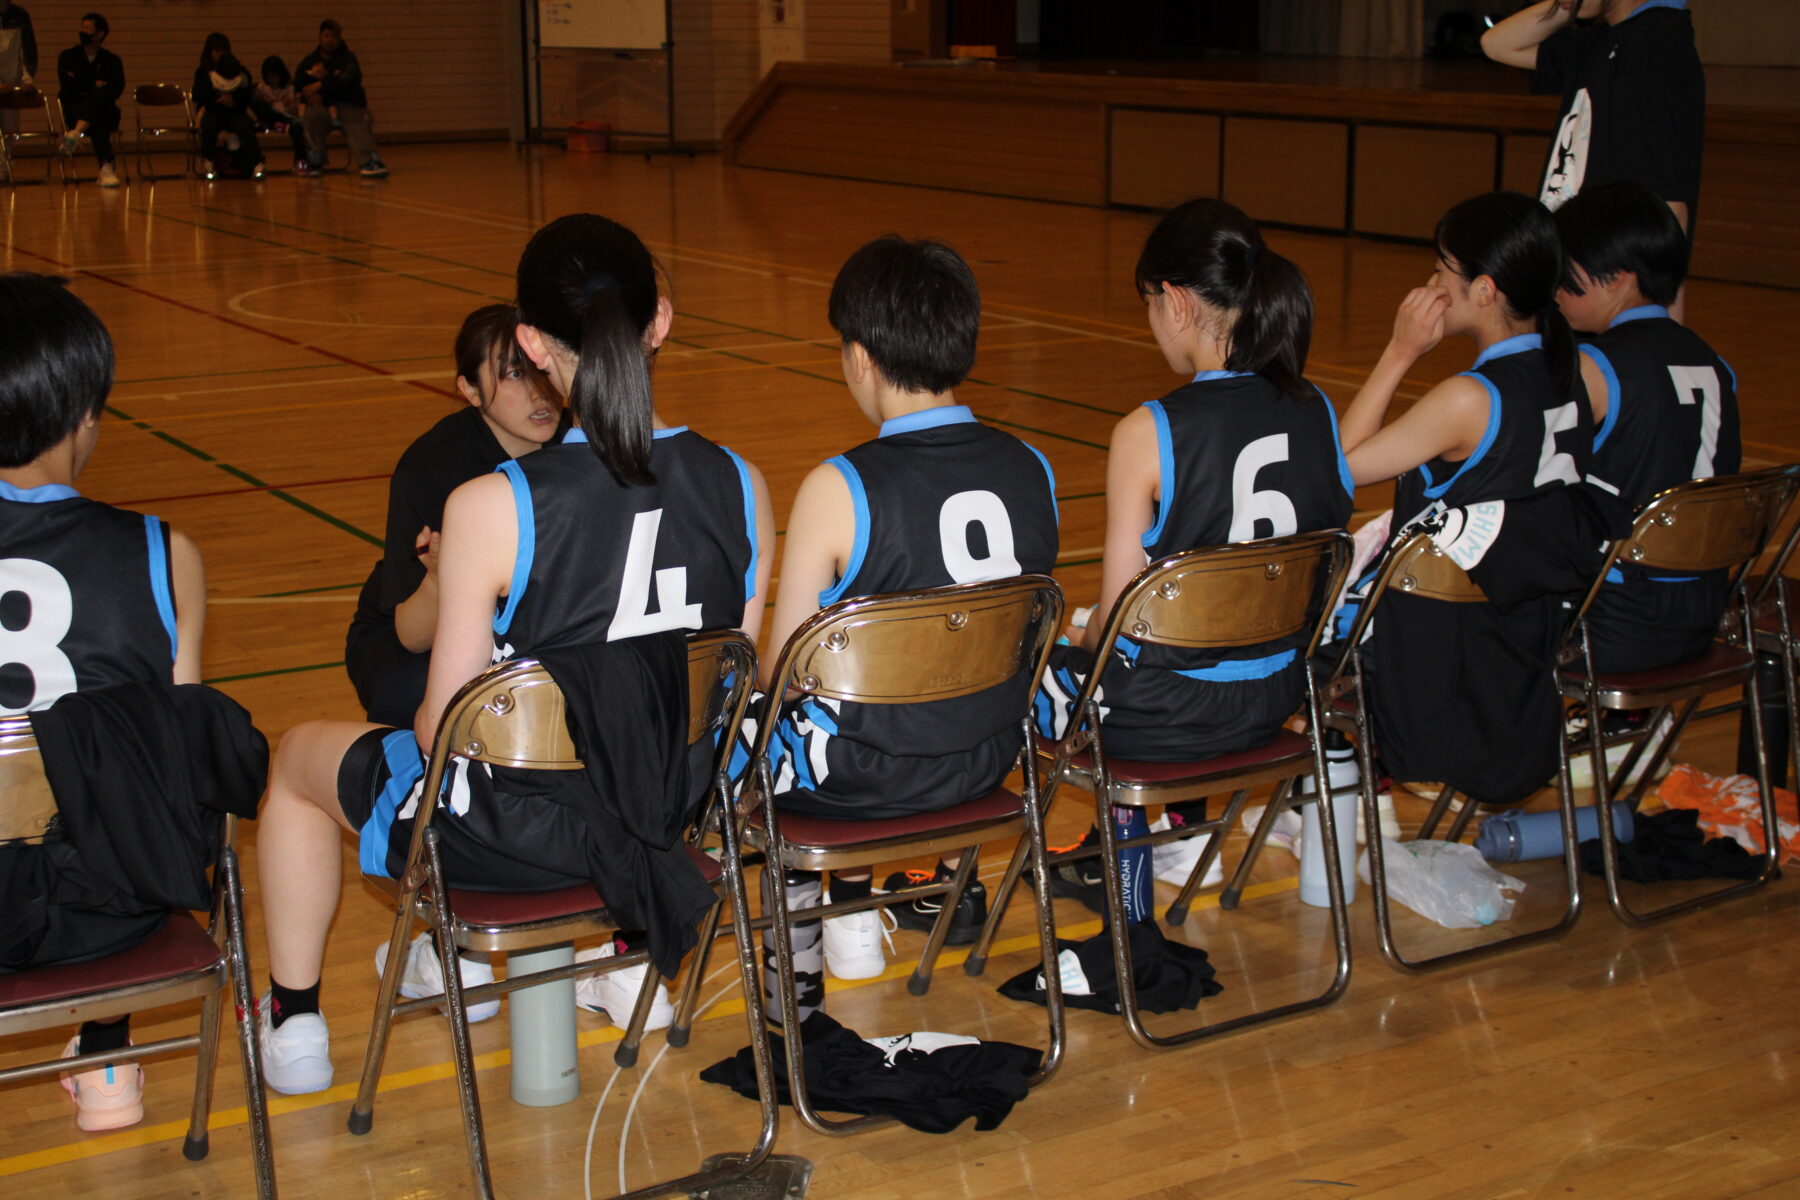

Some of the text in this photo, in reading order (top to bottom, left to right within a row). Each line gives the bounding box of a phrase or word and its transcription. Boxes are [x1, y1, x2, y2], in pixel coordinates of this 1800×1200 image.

[1533, 401, 1582, 488] 5
[1666, 365, 1721, 480] 7
[1227, 433, 1298, 544] 6
[606, 508, 702, 642] 4
[0, 558, 78, 716] 8
[1120, 859, 1133, 920] HYDRATIO
